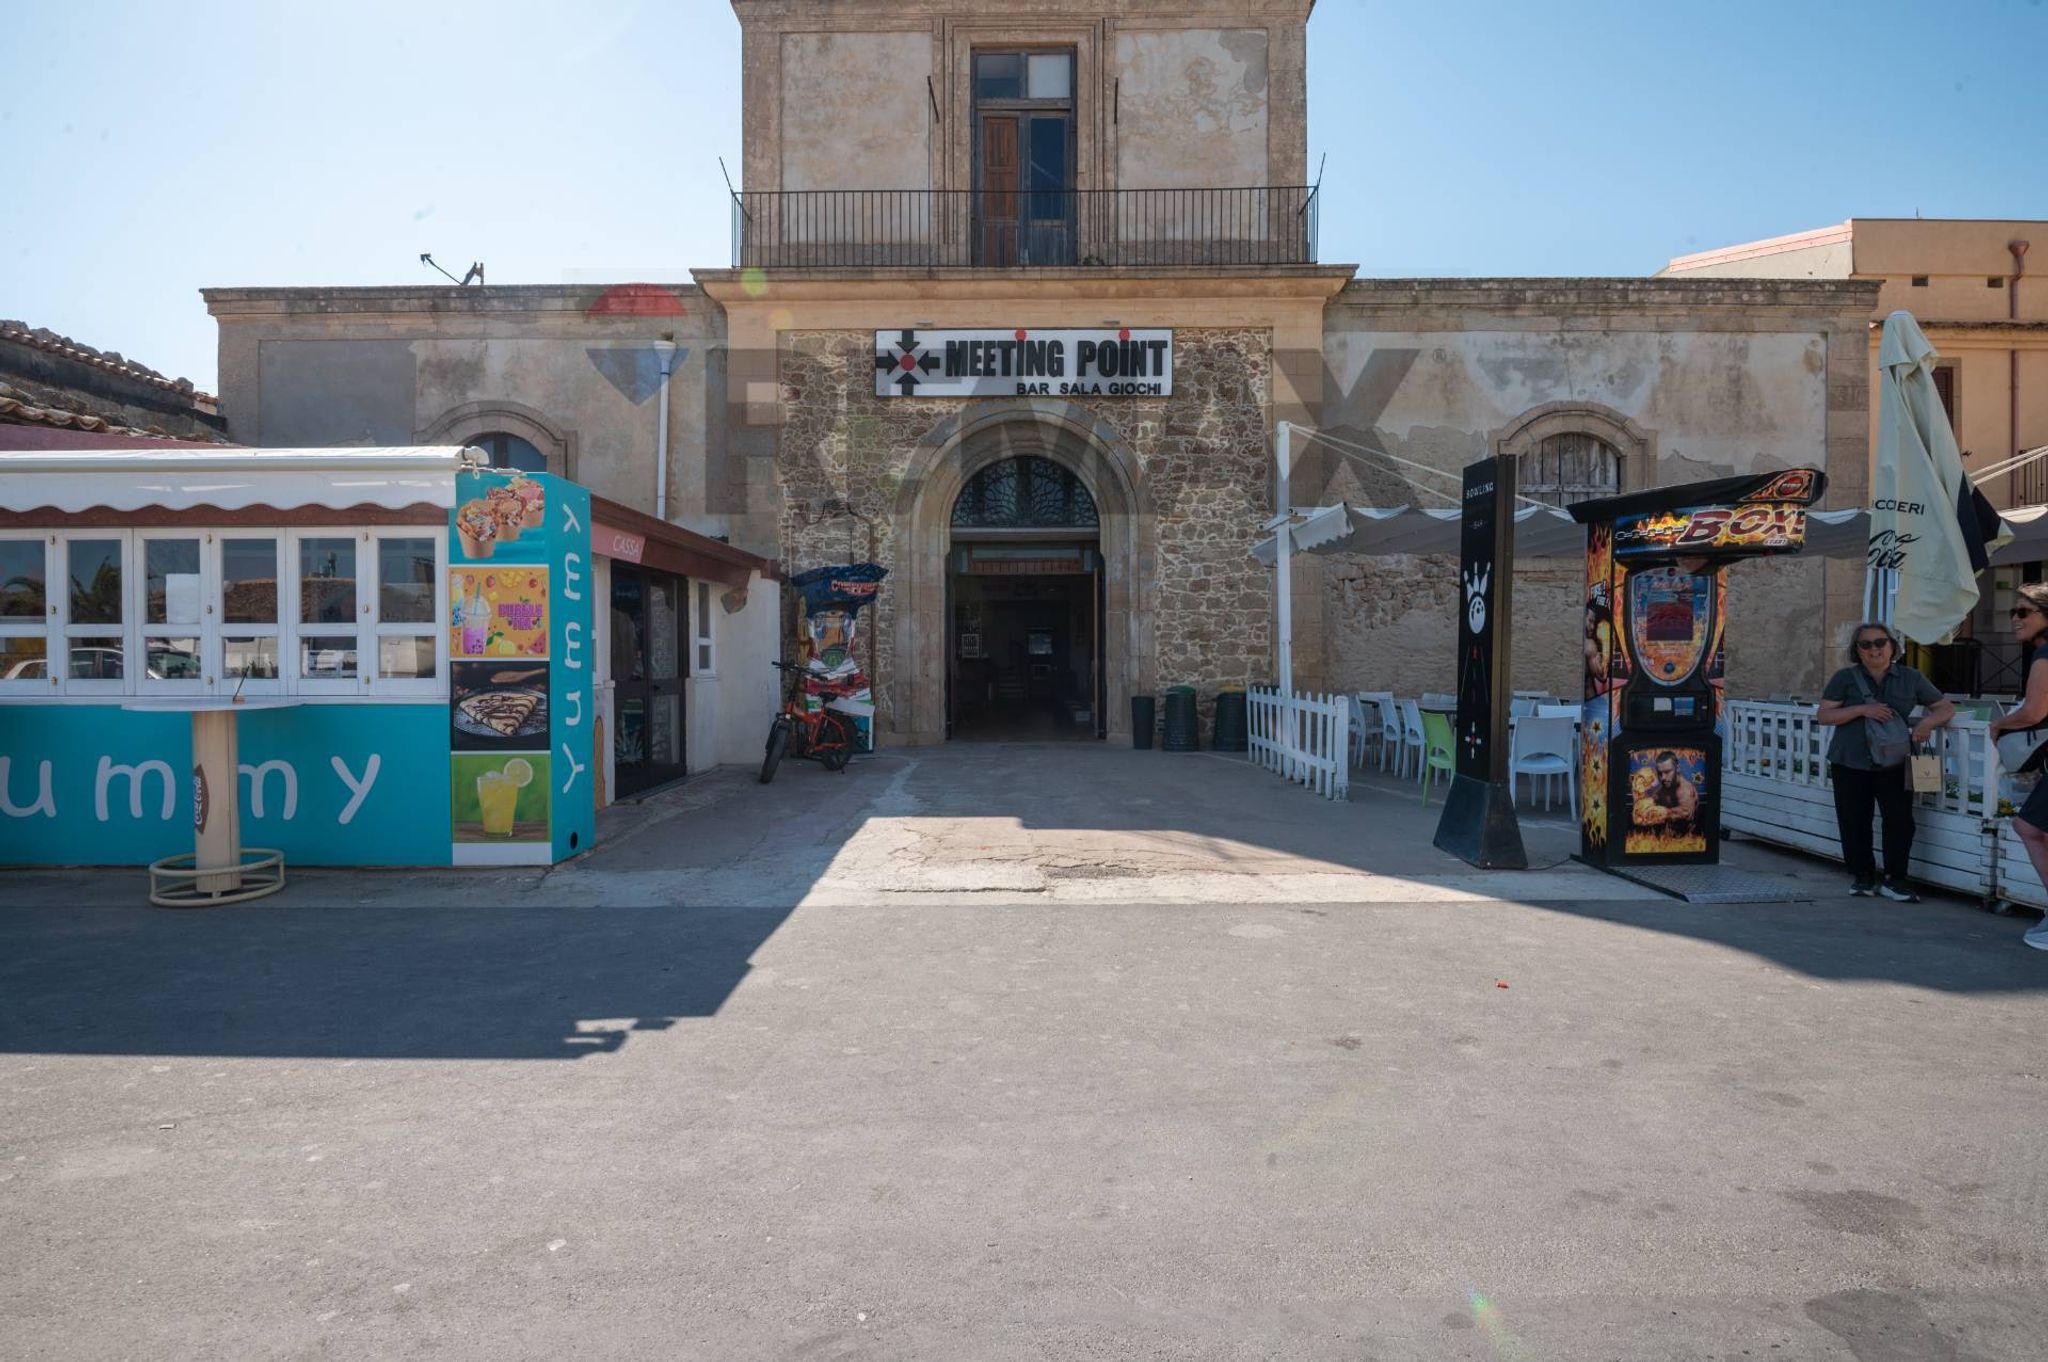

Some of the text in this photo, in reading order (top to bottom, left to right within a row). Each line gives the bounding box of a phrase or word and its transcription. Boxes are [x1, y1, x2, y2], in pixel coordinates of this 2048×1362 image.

[945, 331, 1168, 377] MEETING POINT
[1016, 383, 1162, 395] BAR SALA GIOCHI
[1465, 481, 1494, 499] BOWLING
[612, 535, 641, 557] CASSA
[561, 502, 586, 794] Yummy
